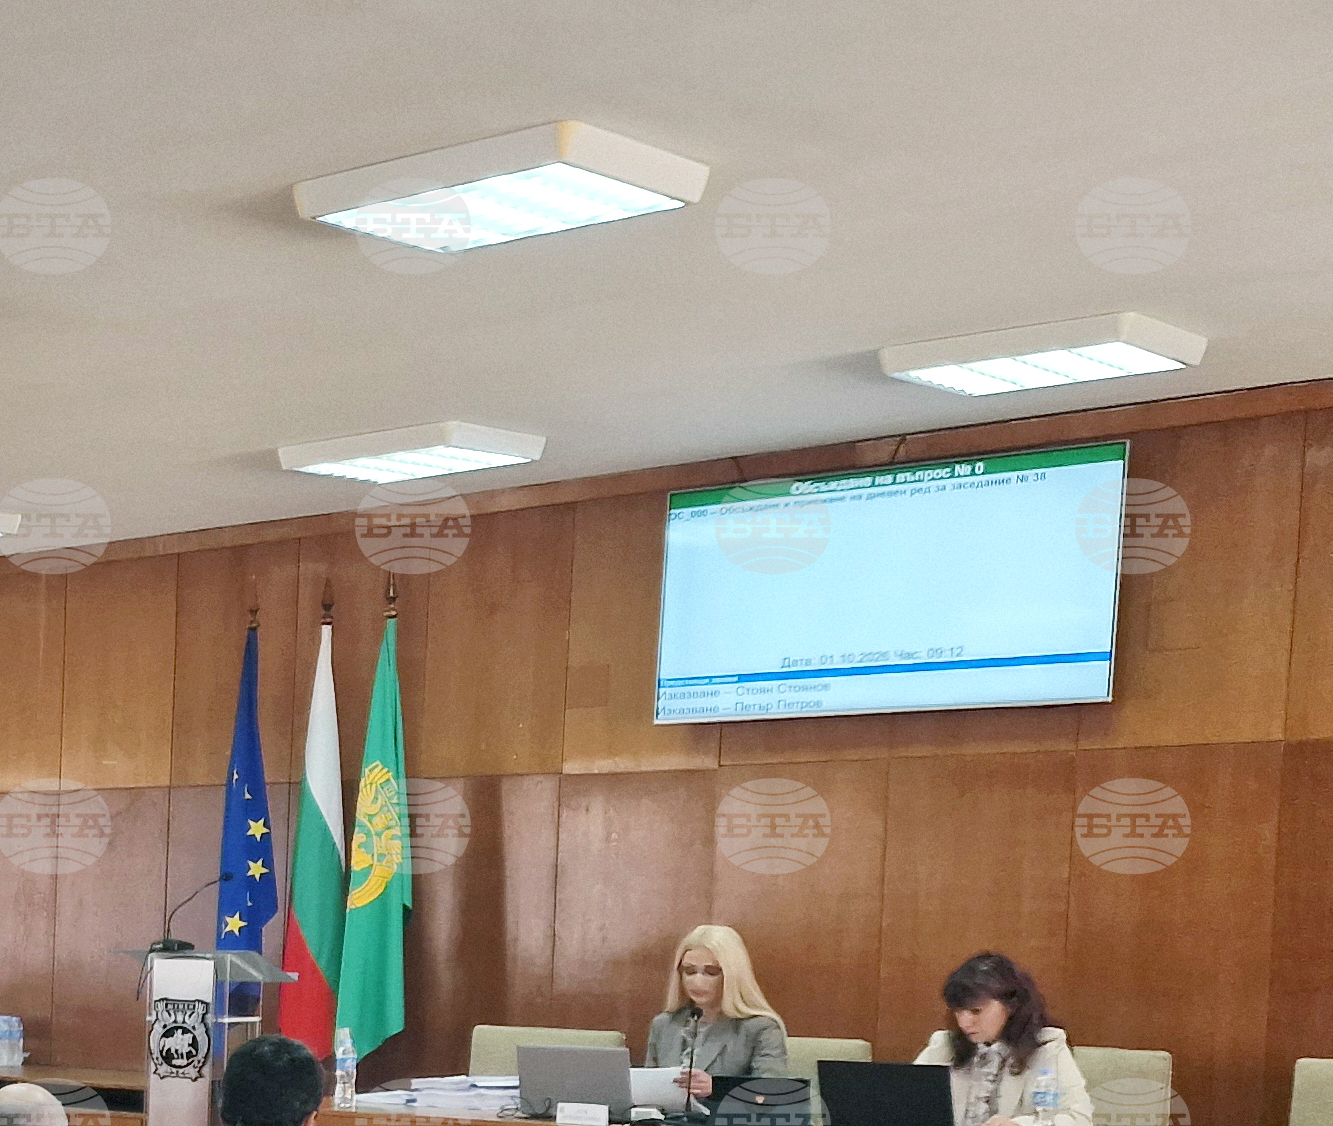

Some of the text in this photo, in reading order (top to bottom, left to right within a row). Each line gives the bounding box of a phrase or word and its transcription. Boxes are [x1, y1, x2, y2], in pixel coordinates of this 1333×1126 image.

[875, 474, 895, 486] на
[896, 467, 953, 483] въпрос
[974, 461, 984, 475] 0
[910, 486, 931, 497] ред
[951, 477, 1012, 491] заседание
[736, 685, 774, 697] Стоян
[735, 701, 773, 713] Петър
[778, 700, 823, 711] Петров
